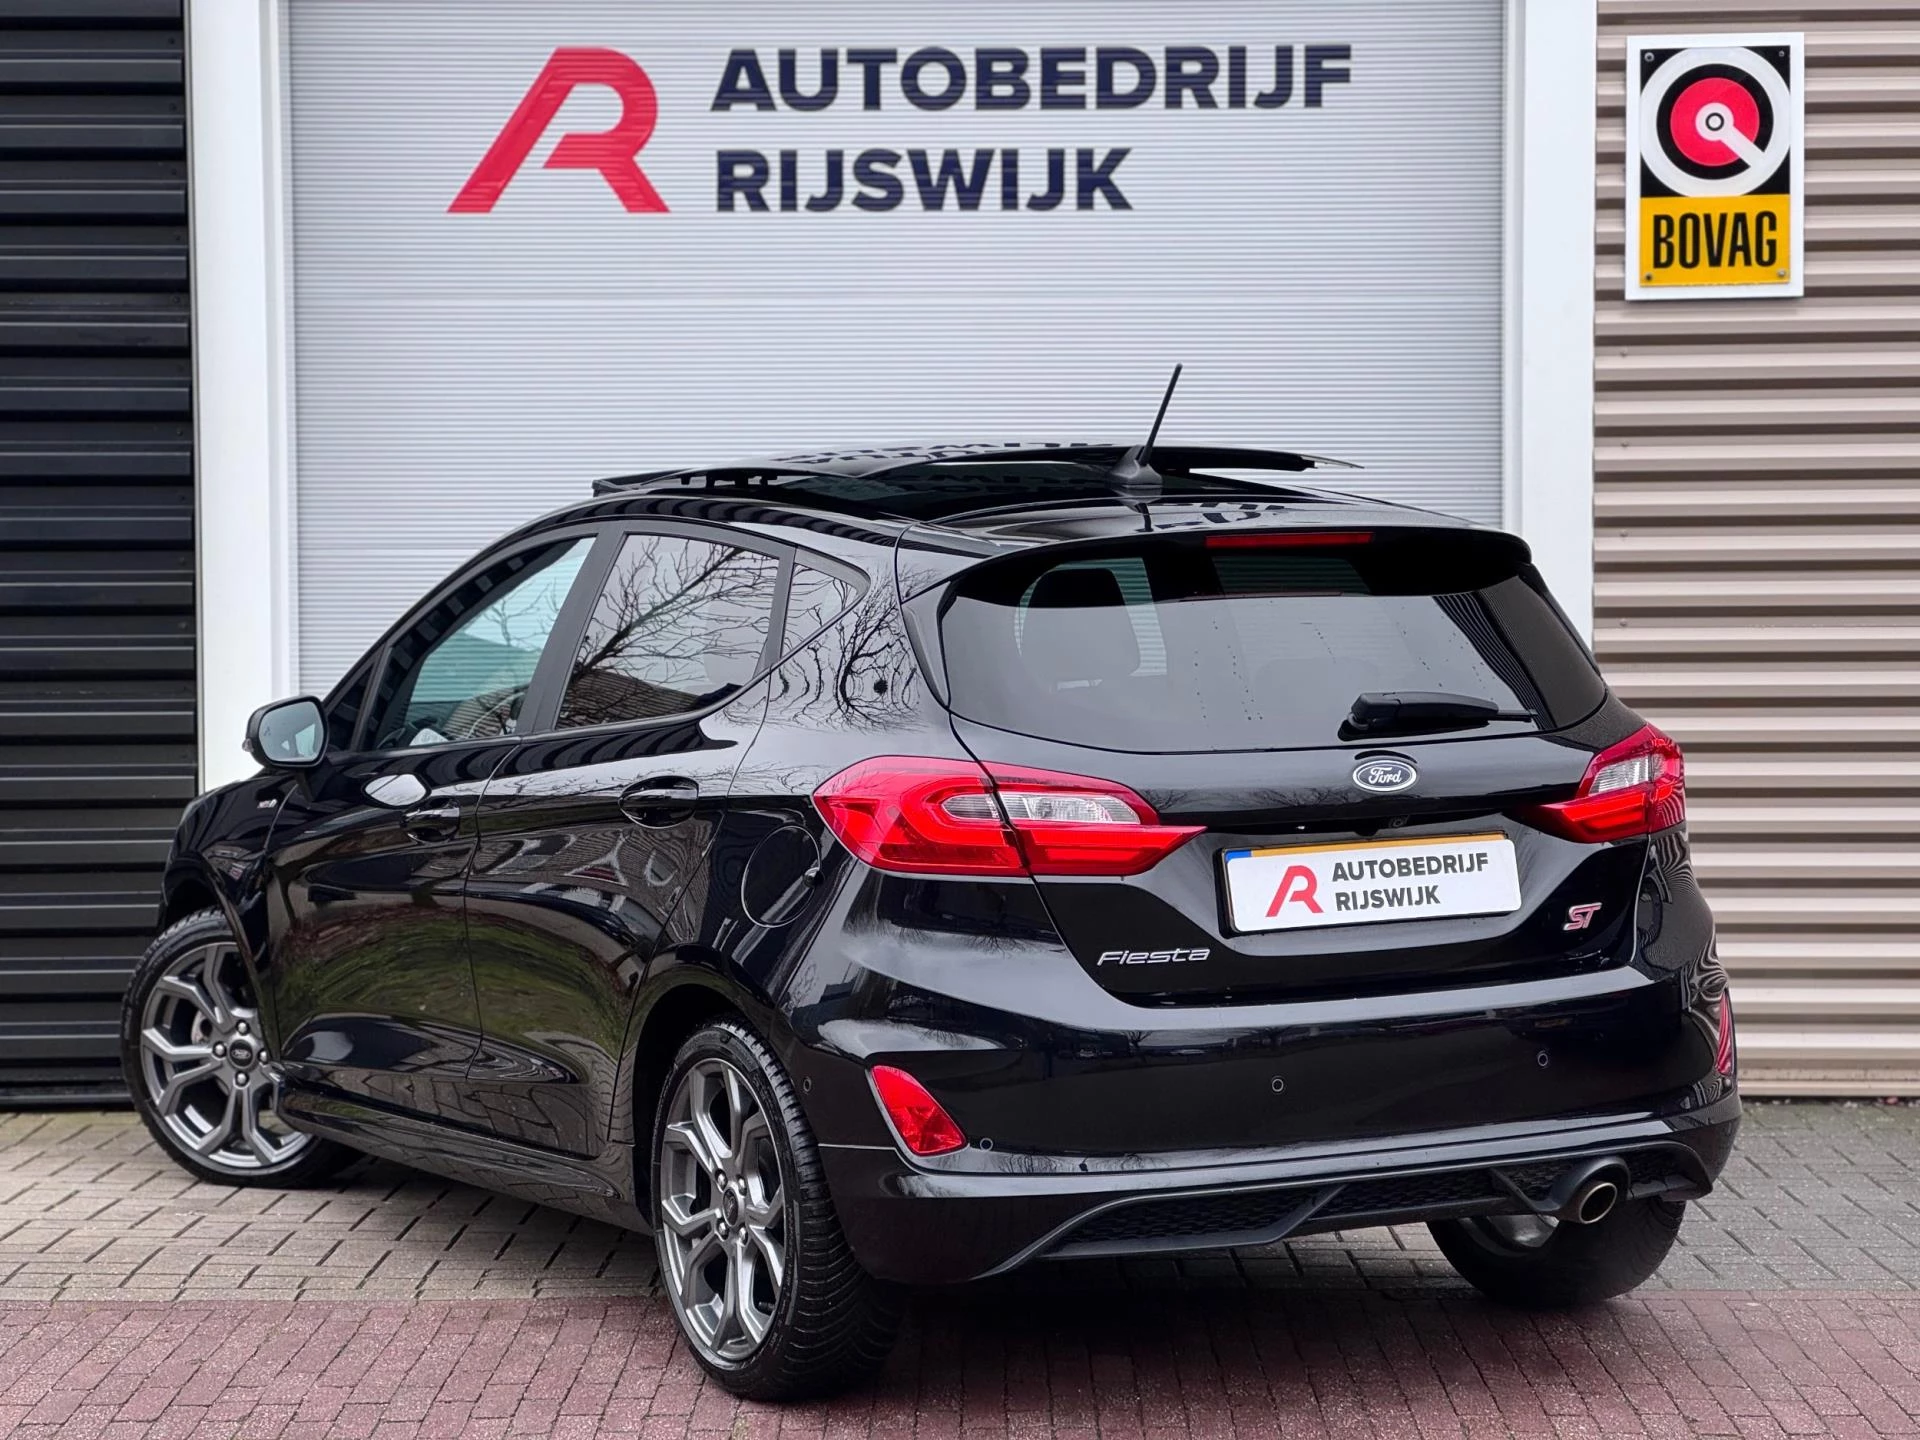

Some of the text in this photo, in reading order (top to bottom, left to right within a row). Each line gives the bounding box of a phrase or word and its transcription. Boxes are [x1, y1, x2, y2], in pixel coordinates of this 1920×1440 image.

[711, 44, 1352, 112] AUTOBEDRIJF
[715, 148, 1133, 212] RIJSWIJK
[1653, 211, 1777, 268] BOVAG
[1368, 766, 1402, 784] Ford
[1332, 852, 1489, 881] AUTOBEDRIJF
[1335, 885, 1441, 911] RIJSWIJK
[1563, 902, 1603, 931] ST
[1096, 948, 1210, 966] Fiesta
